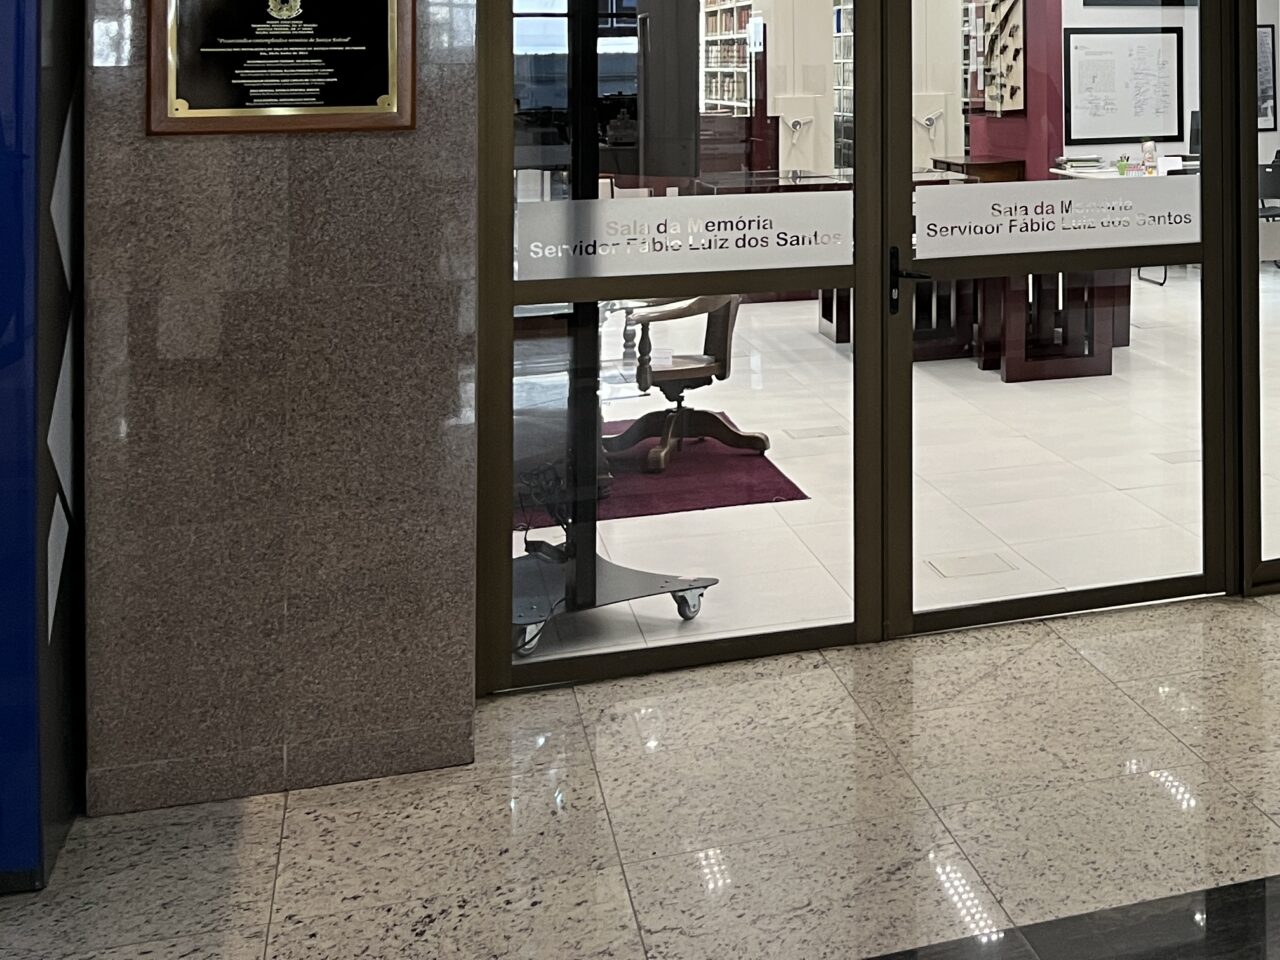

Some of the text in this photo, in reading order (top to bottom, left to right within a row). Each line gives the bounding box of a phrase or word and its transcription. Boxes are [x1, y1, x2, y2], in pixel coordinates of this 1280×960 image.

[991, 203, 1028, 218] Sala
[1034, 201, 1055, 216] da
[605, 215, 774, 237] Sala da Memória
[926, 221, 1004, 238] Servidor
[1136, 211, 1192, 227] Santos
[529, 238, 619, 258] Servidor
[734, 232, 770, 249] dos
[775, 229, 843, 248] Santos
